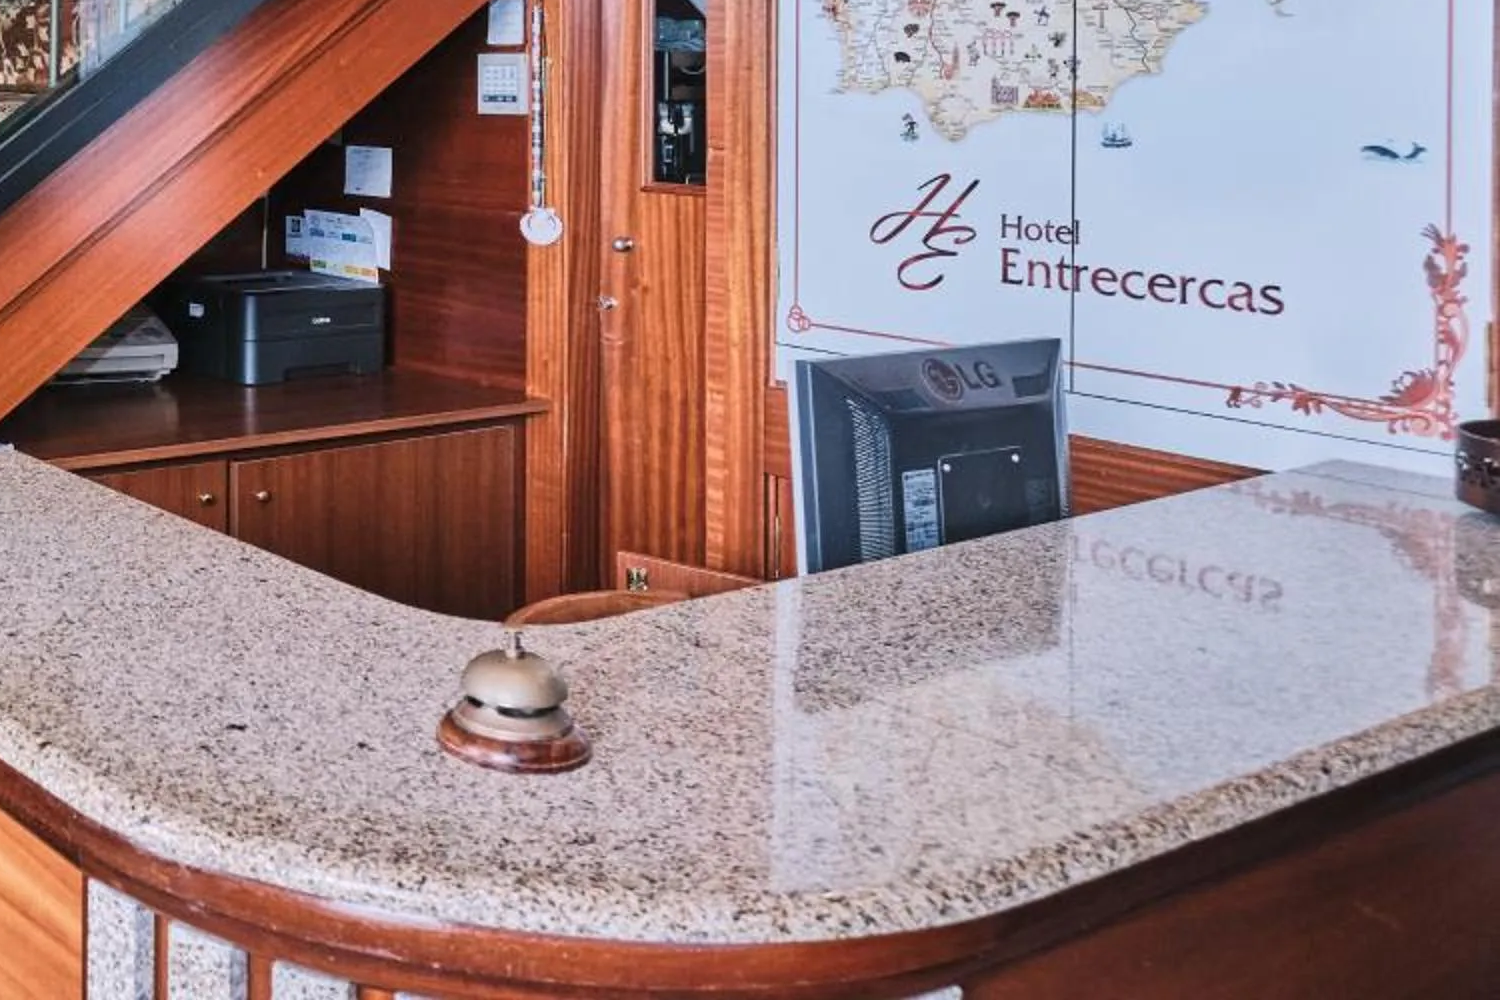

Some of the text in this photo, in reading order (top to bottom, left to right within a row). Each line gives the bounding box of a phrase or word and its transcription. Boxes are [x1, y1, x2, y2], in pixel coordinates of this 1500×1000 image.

[1000, 213, 1080, 245] Hotel
[1000, 247, 1286, 316] Entrecercas
[955, 359, 1002, 390] LG
